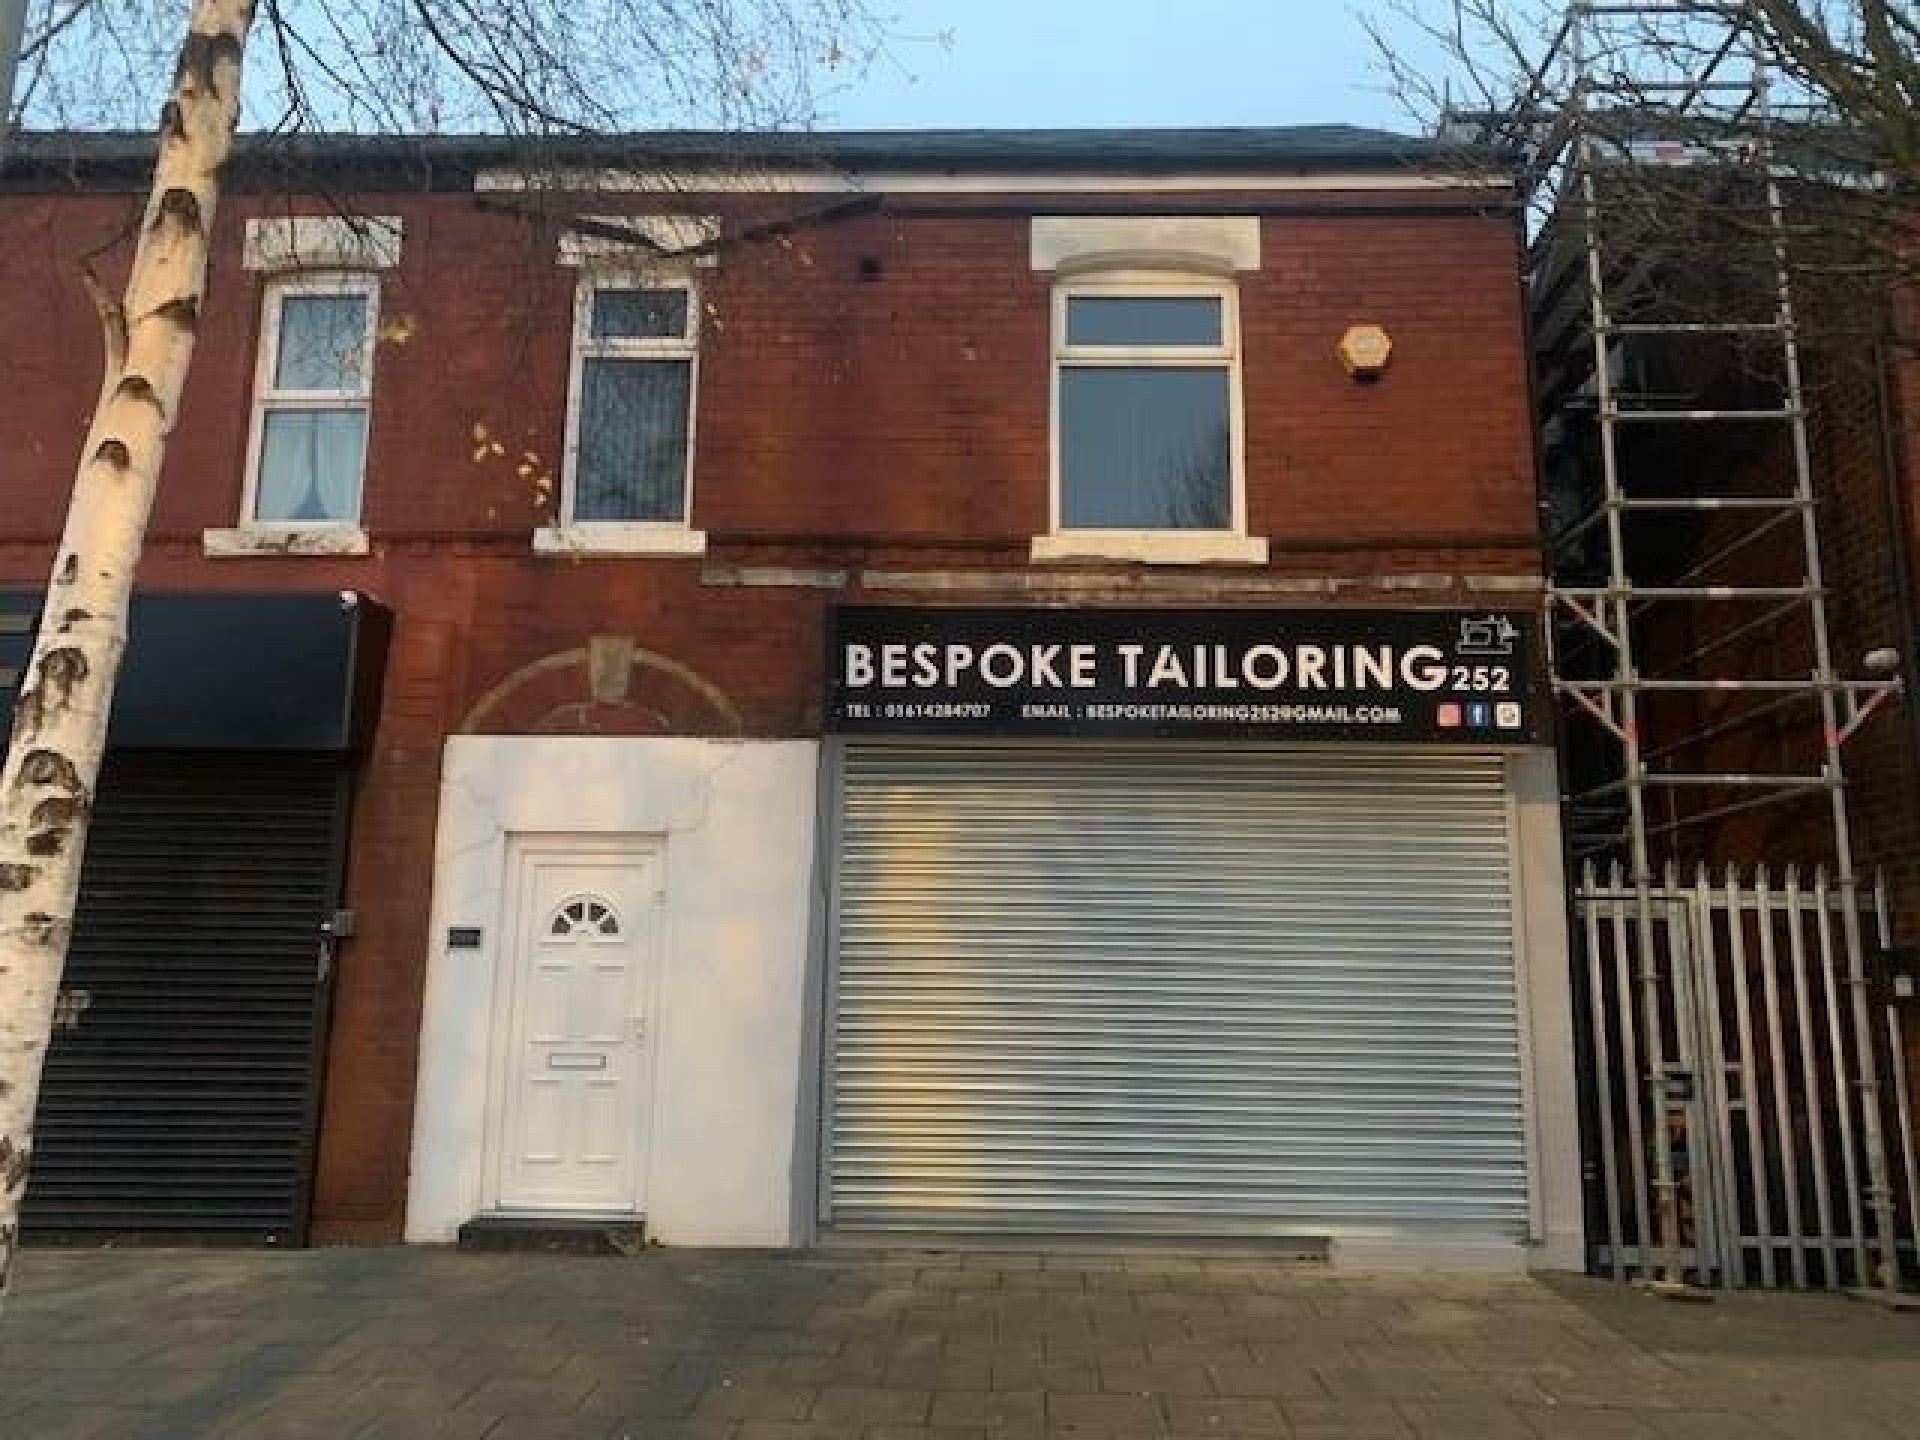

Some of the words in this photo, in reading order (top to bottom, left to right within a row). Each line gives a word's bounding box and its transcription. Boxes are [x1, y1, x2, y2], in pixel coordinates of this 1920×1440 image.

[845, 643, 1096, 688] BESPOKE
[1118, 643, 1448, 691] TAILORING
[1451, 665, 1510, 691] 252
[847, 704, 871, 719] TEL
[1022, 704, 1072, 719] EMAIL
